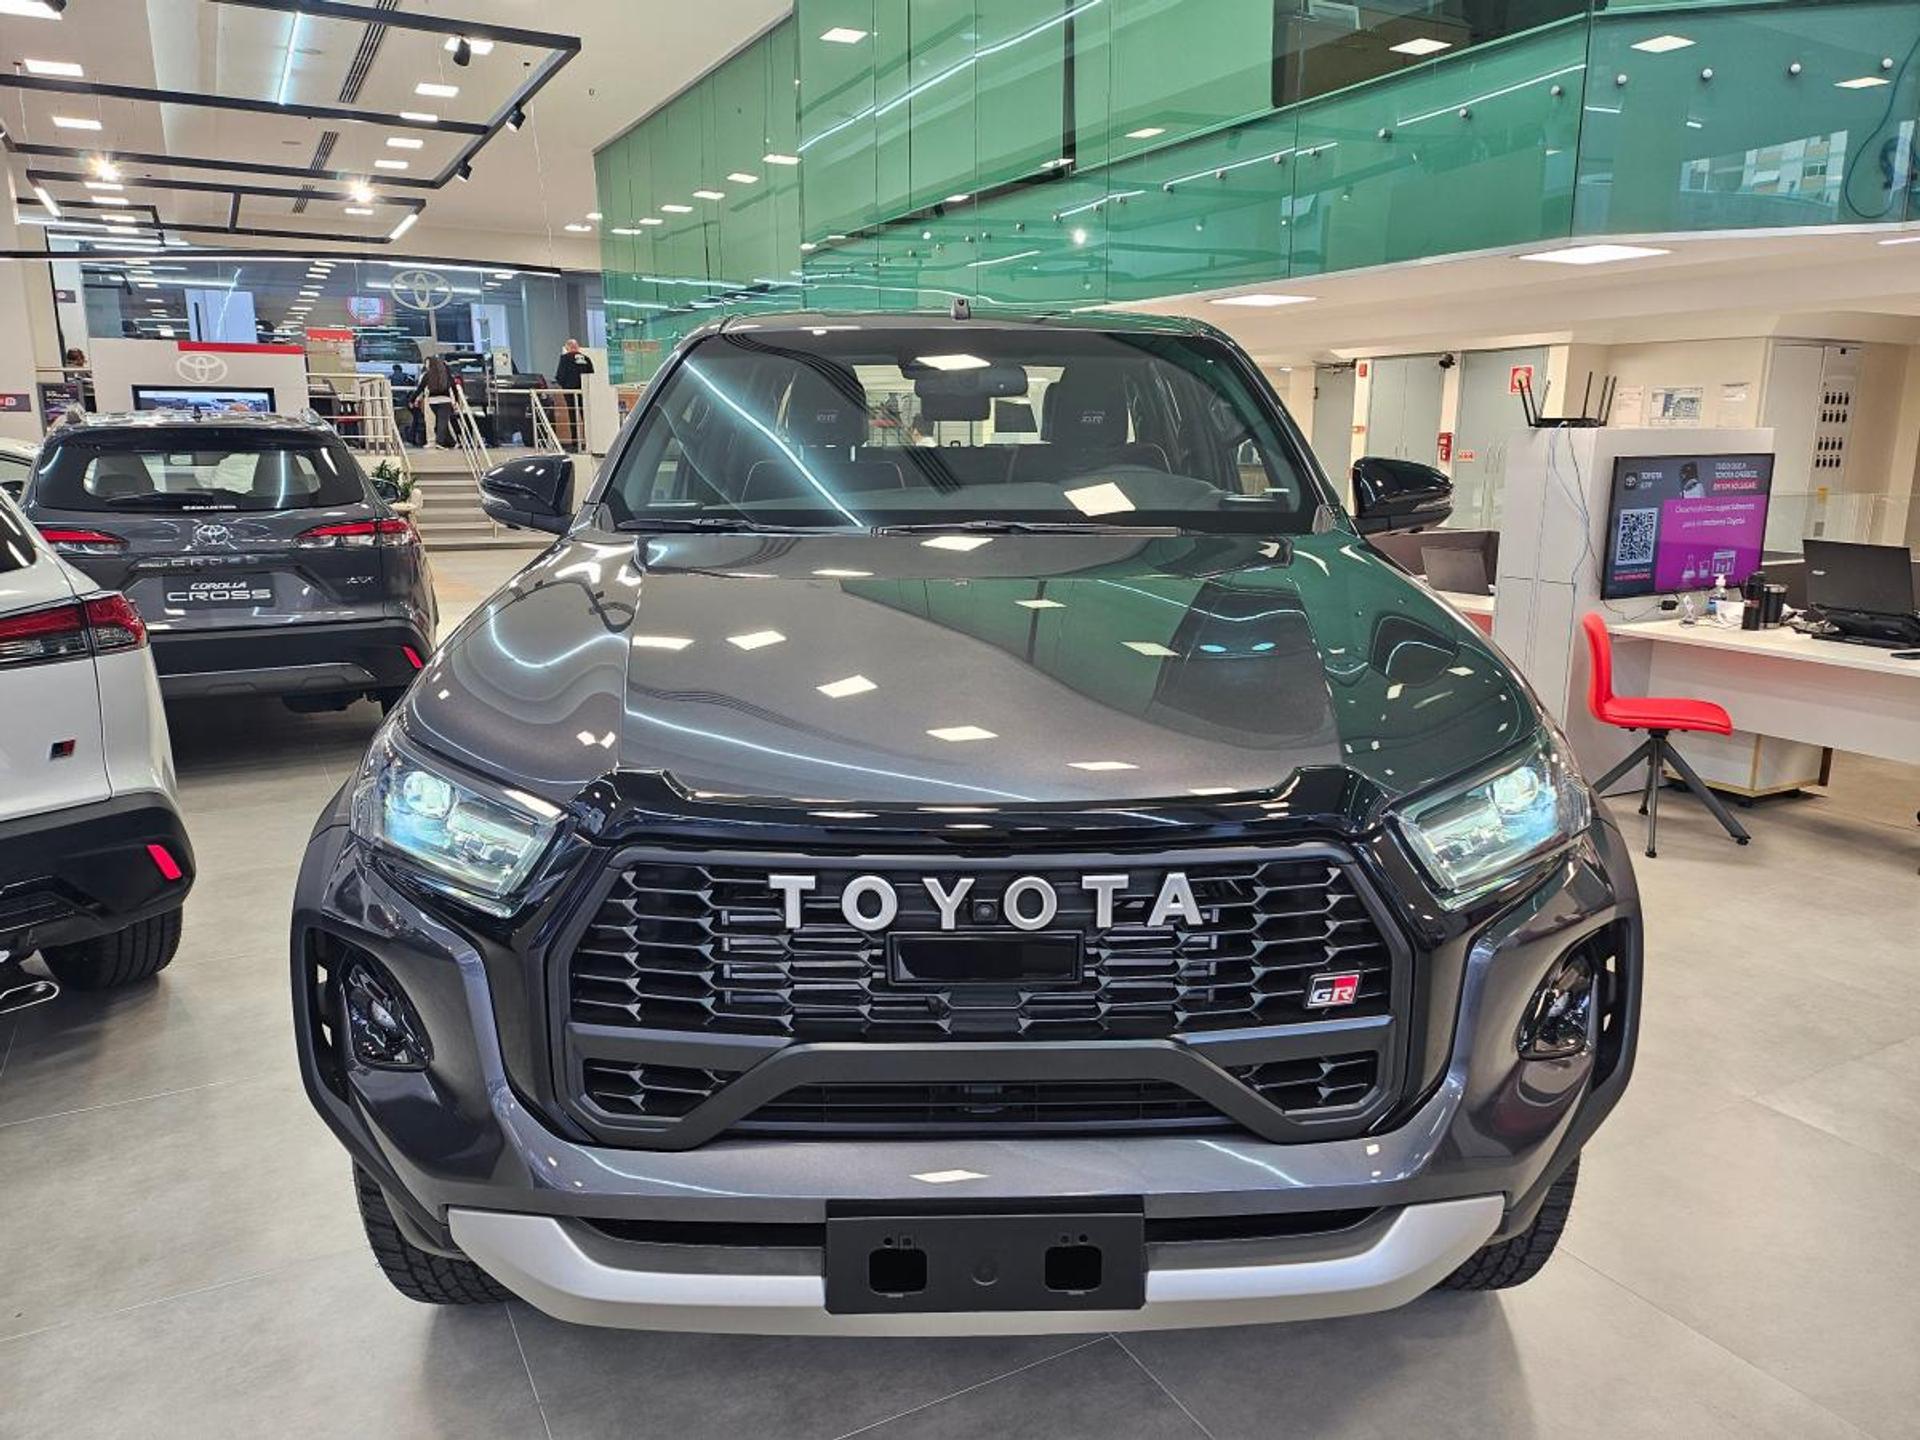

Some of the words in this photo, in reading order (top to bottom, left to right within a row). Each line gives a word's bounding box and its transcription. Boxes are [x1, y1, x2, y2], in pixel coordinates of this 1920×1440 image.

[190, 581, 247, 590] COROLLA
[167, 589, 271, 602] CROSS
[768, 872, 1204, 931] TOYOTA
